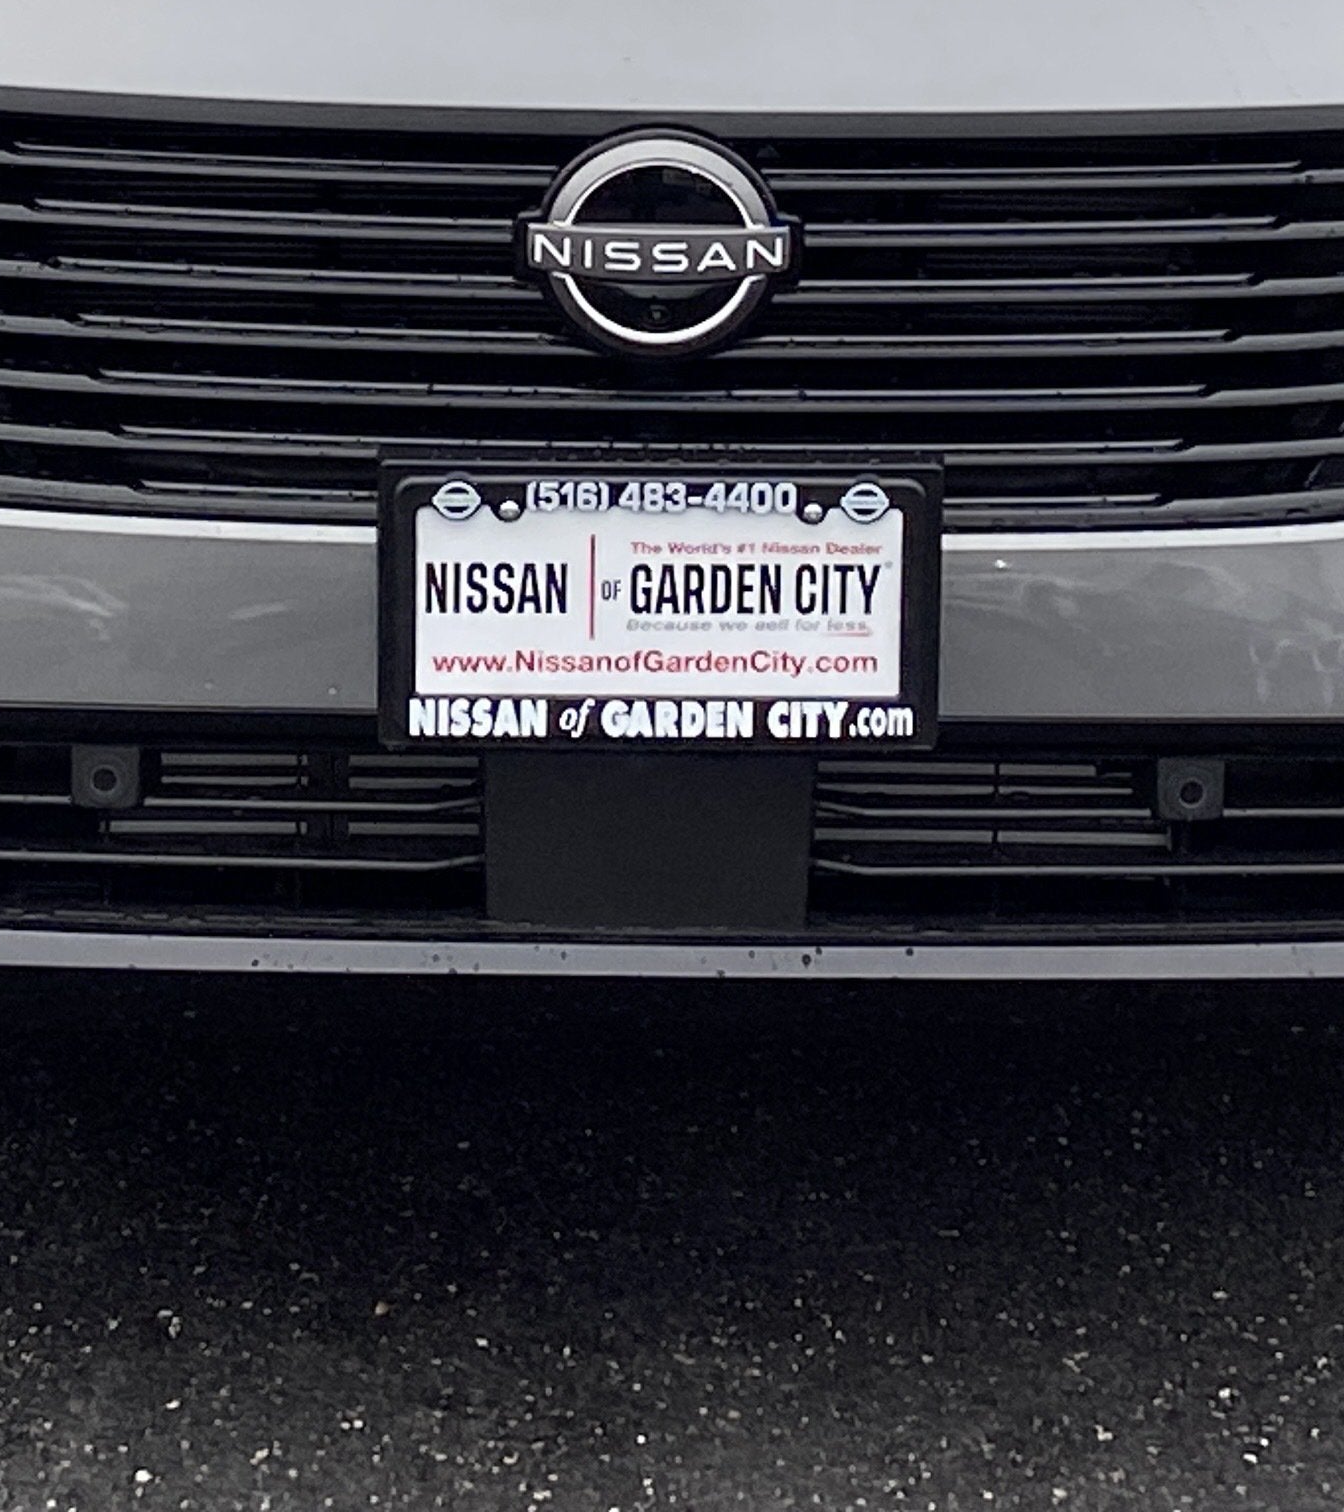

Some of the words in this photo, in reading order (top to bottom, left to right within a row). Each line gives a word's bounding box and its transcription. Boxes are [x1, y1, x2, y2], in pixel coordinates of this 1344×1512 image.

[533, 233, 784, 274] NISSAN
[526, 480, 610, 513] (516)
[618, 481, 798, 515] 483-4400
[630, 541, 662, 555] The
[761, 541, 821, 555] Nissan
[825, 541, 884, 556] Dealer
[424, 562, 569, 615] NISSAN
[600, 579, 622, 602] OF
[630, 563, 782, 616] GARDEN
[795, 564, 882, 616] CITY
[626, 618, 713, 633] Because
[718, 620, 749, 633] we
[432, 649, 879, 679] www.NissanofGardenCity.com
[409, 697, 549, 738] NISSAN
[559, 697, 596, 739] of
[600, 699, 754, 739] GARDEN
[767, 700, 915, 739] CITY.com
